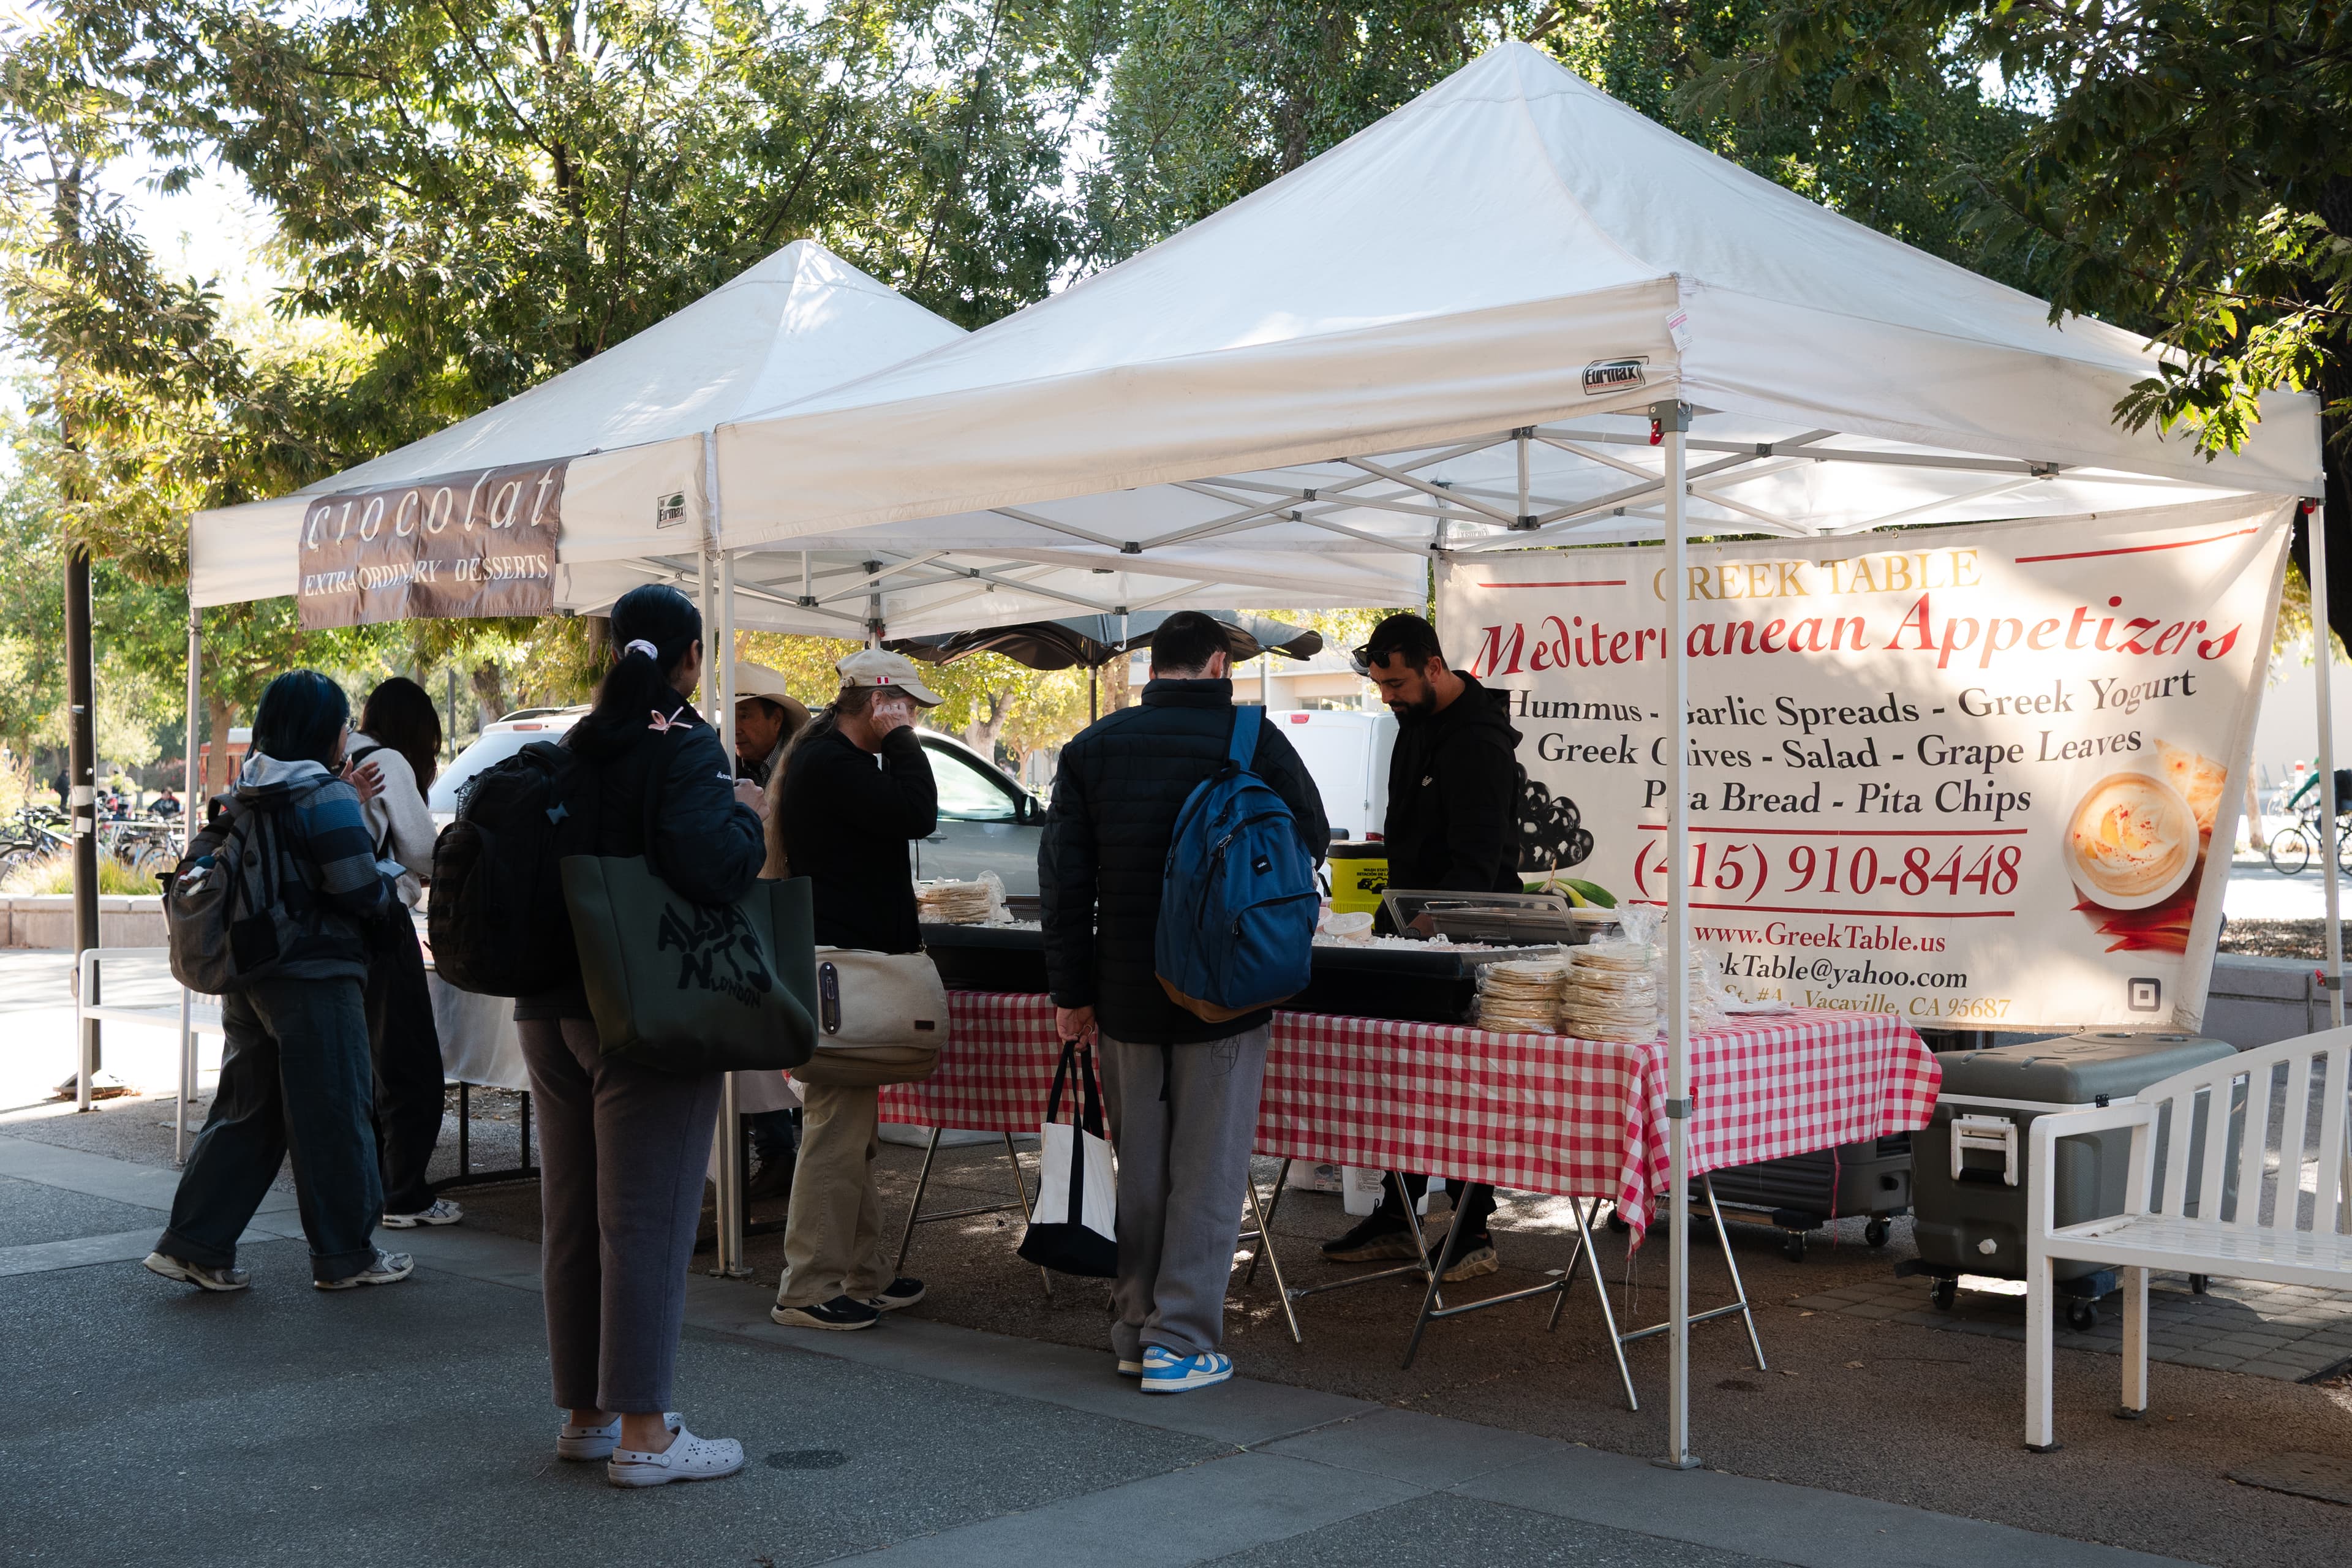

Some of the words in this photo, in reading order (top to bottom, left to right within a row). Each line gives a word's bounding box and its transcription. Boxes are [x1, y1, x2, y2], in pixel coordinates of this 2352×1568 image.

[1585, 366, 1637, 385] Eurmax
[659, 507, 684, 522] Eurmax
[455, 554, 548, 582] DESSERTS
[1820, 549, 1982, 595] TABLE
[1470, 615, 1871, 679] Mediteranean
[1883, 592, 2243, 669] Appetizers
[1510, 690, 1642, 722] Hummus
[1687, 695, 1767, 726] arlic
[1777, 693, 1919, 734] Spreads
[1958, 679, 2074, 717] Greek
[2088, 669, 2196, 715] Yogurt
[1538, 733, 1638, 763] Greek
[1782, 737, 1880, 769] Salad
[1917, 734, 2024, 774] Grape
[2036, 729, 2141, 763] Leaves
[1642, 780, 1708, 810] Pa
[1719, 782, 1820, 812] Bread
[1856, 783, 1923, 814] Pita
[1935, 779, 2031, 821] Chips
[1784, 845, 2022, 896] 910-8448
[1694, 922, 1946, 953] www.GreekTable.us
[710, 975, 761, 1009] LONDON
[1804, 990, 1899, 1016] Vacaville,
[1909, 997, 1941, 1017] CA
[1945, 997, 2011, 1019] 95687
